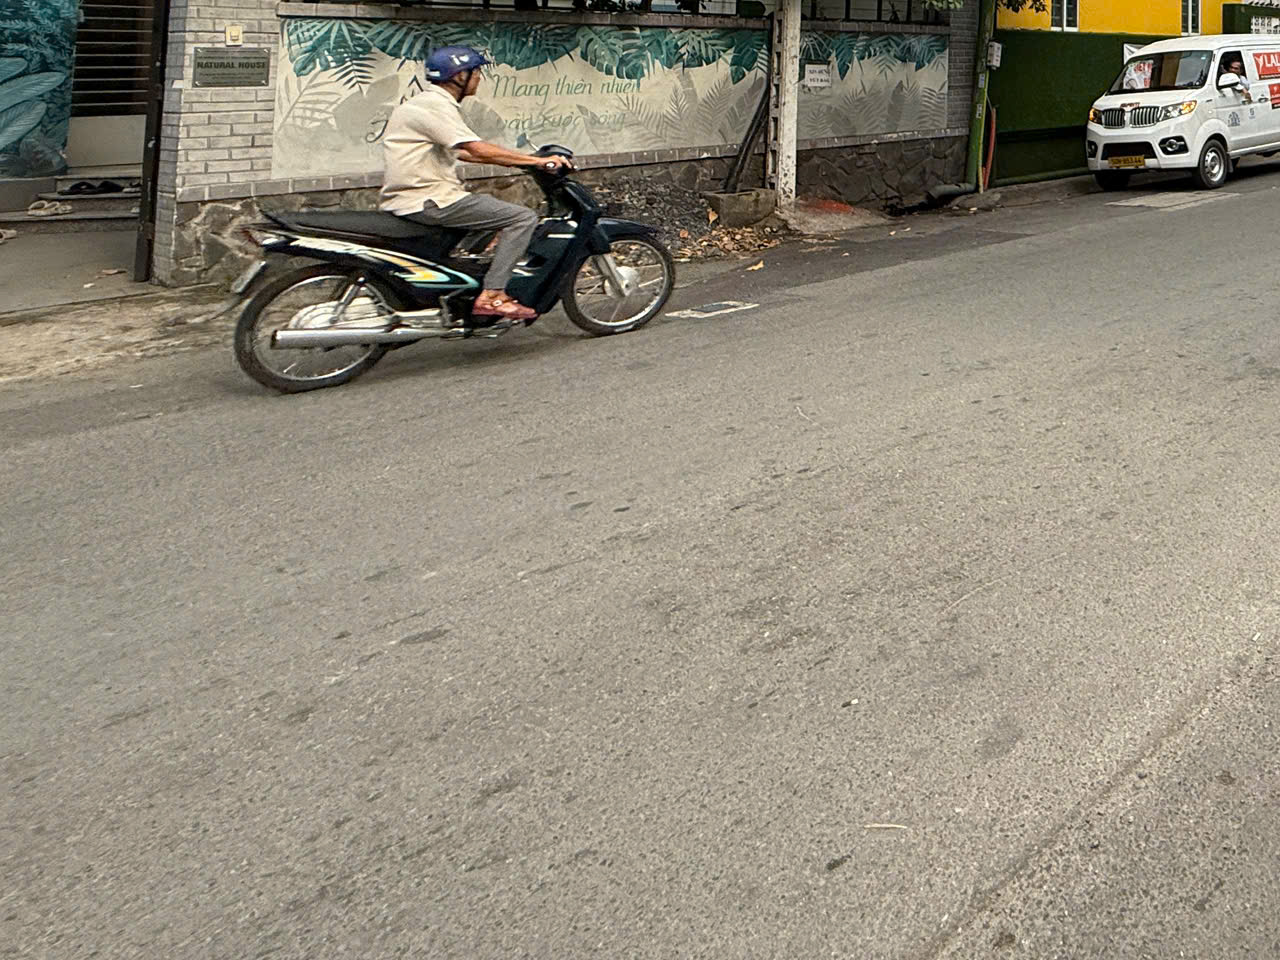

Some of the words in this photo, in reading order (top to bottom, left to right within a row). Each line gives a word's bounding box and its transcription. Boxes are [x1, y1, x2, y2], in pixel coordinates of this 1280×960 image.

[197, 61, 235, 69] NATURAL
[238, 61, 265, 69] HOUSE
[491, 74, 550, 105] Mang
[555, 75, 592, 96] thiên
